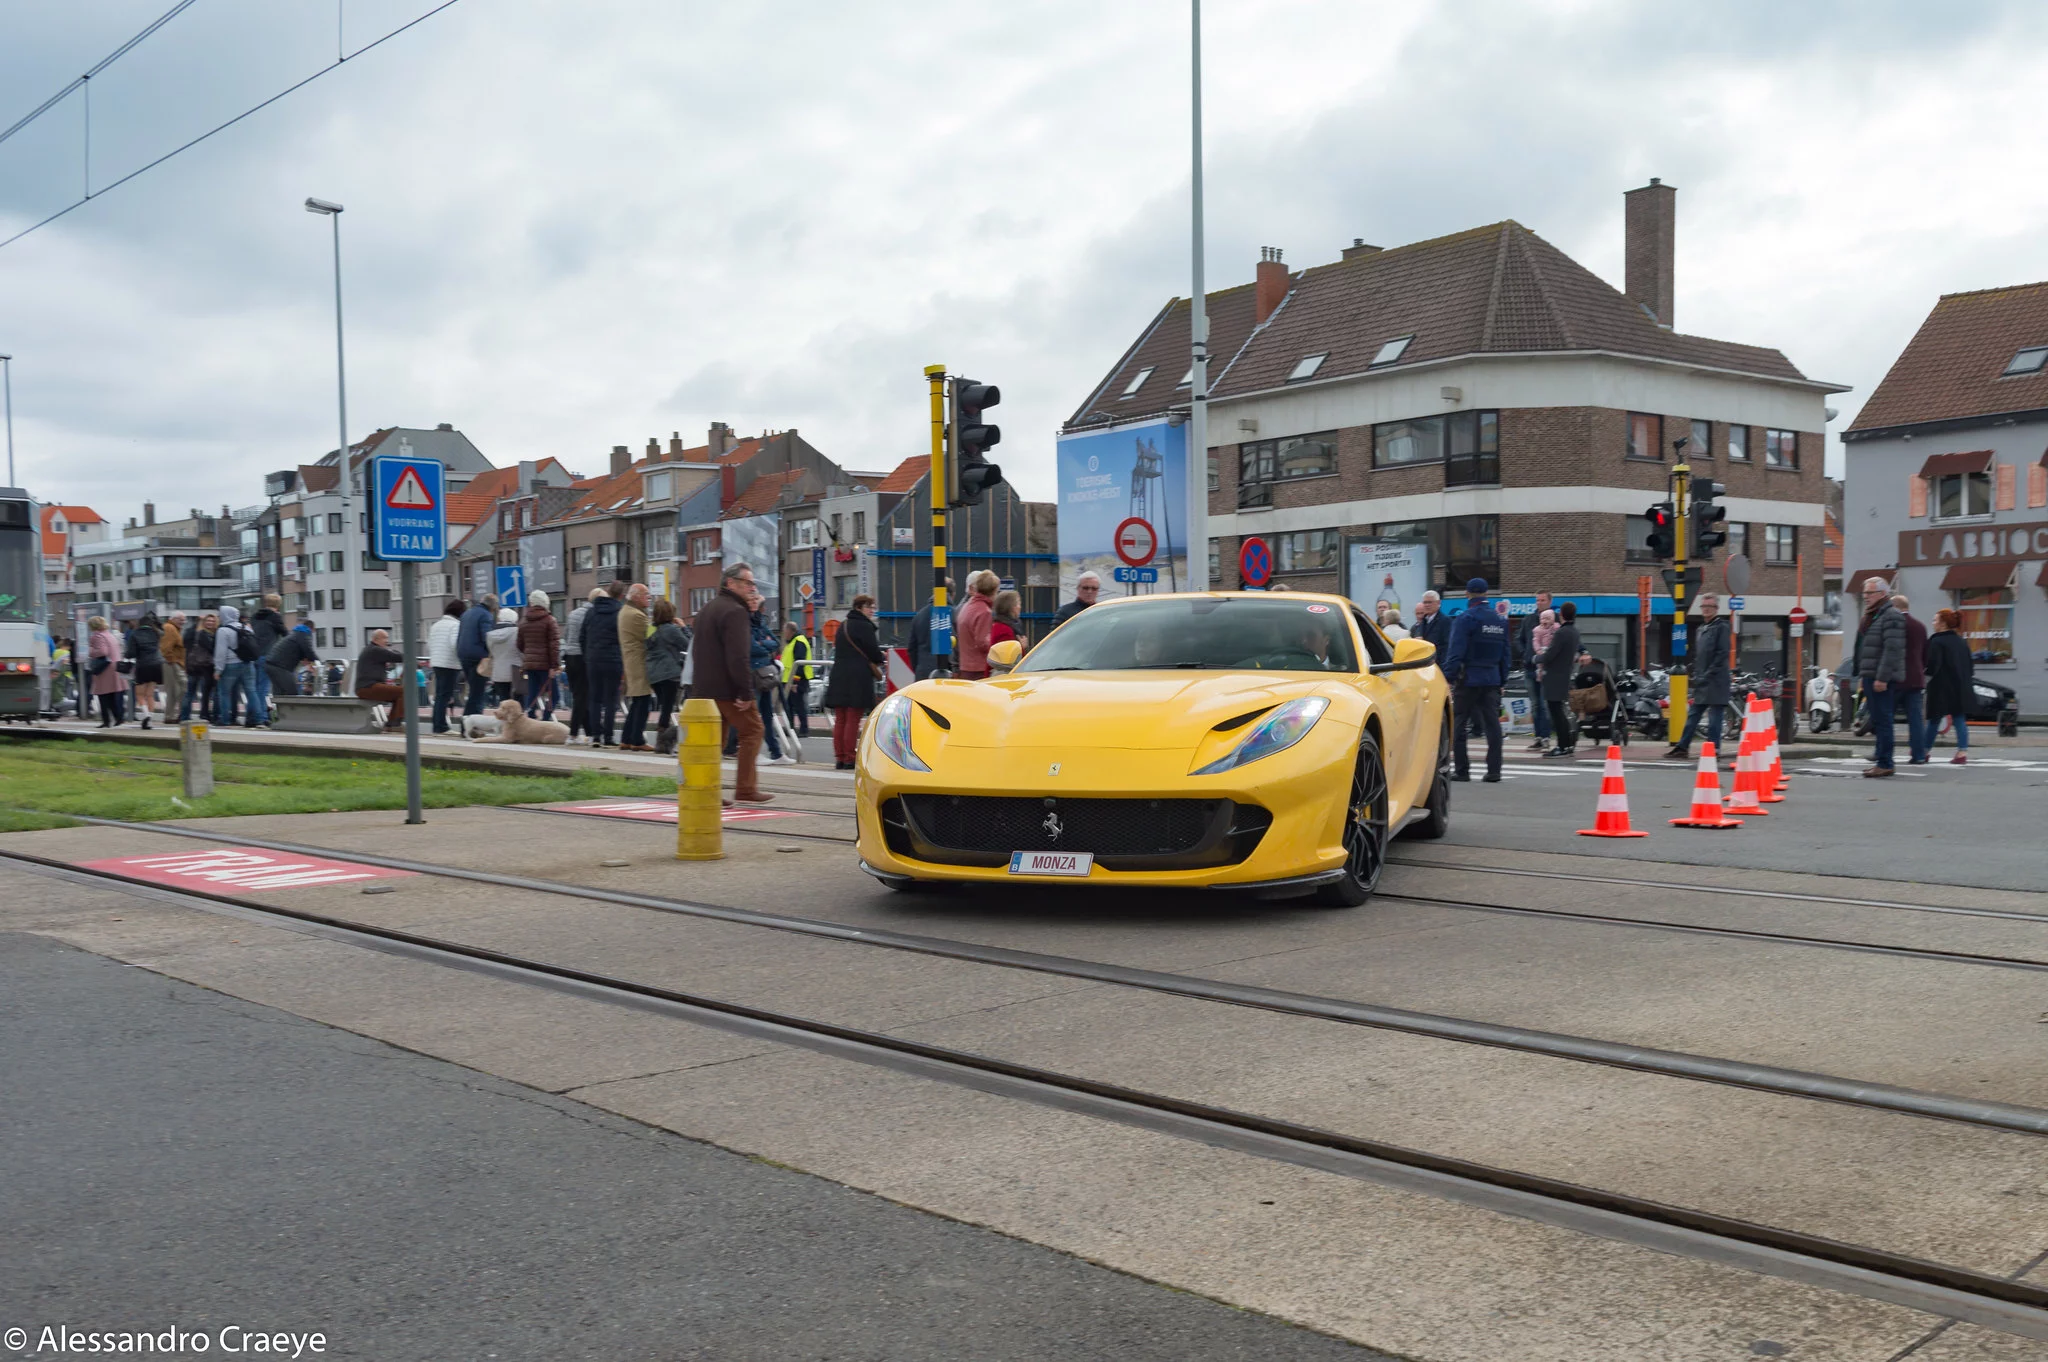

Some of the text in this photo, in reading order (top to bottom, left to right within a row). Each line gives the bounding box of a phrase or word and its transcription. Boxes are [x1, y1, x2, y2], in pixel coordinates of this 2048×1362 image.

[387, 517, 435, 528] VOORRANG
[390, 534, 434, 550] TRAM
[1121, 569, 1153, 582] 50 m
[1482, 624, 1504, 634] Politie
[122, 850, 376, 889] TRAM
[1011, 855, 1077, 871] B MONZA
